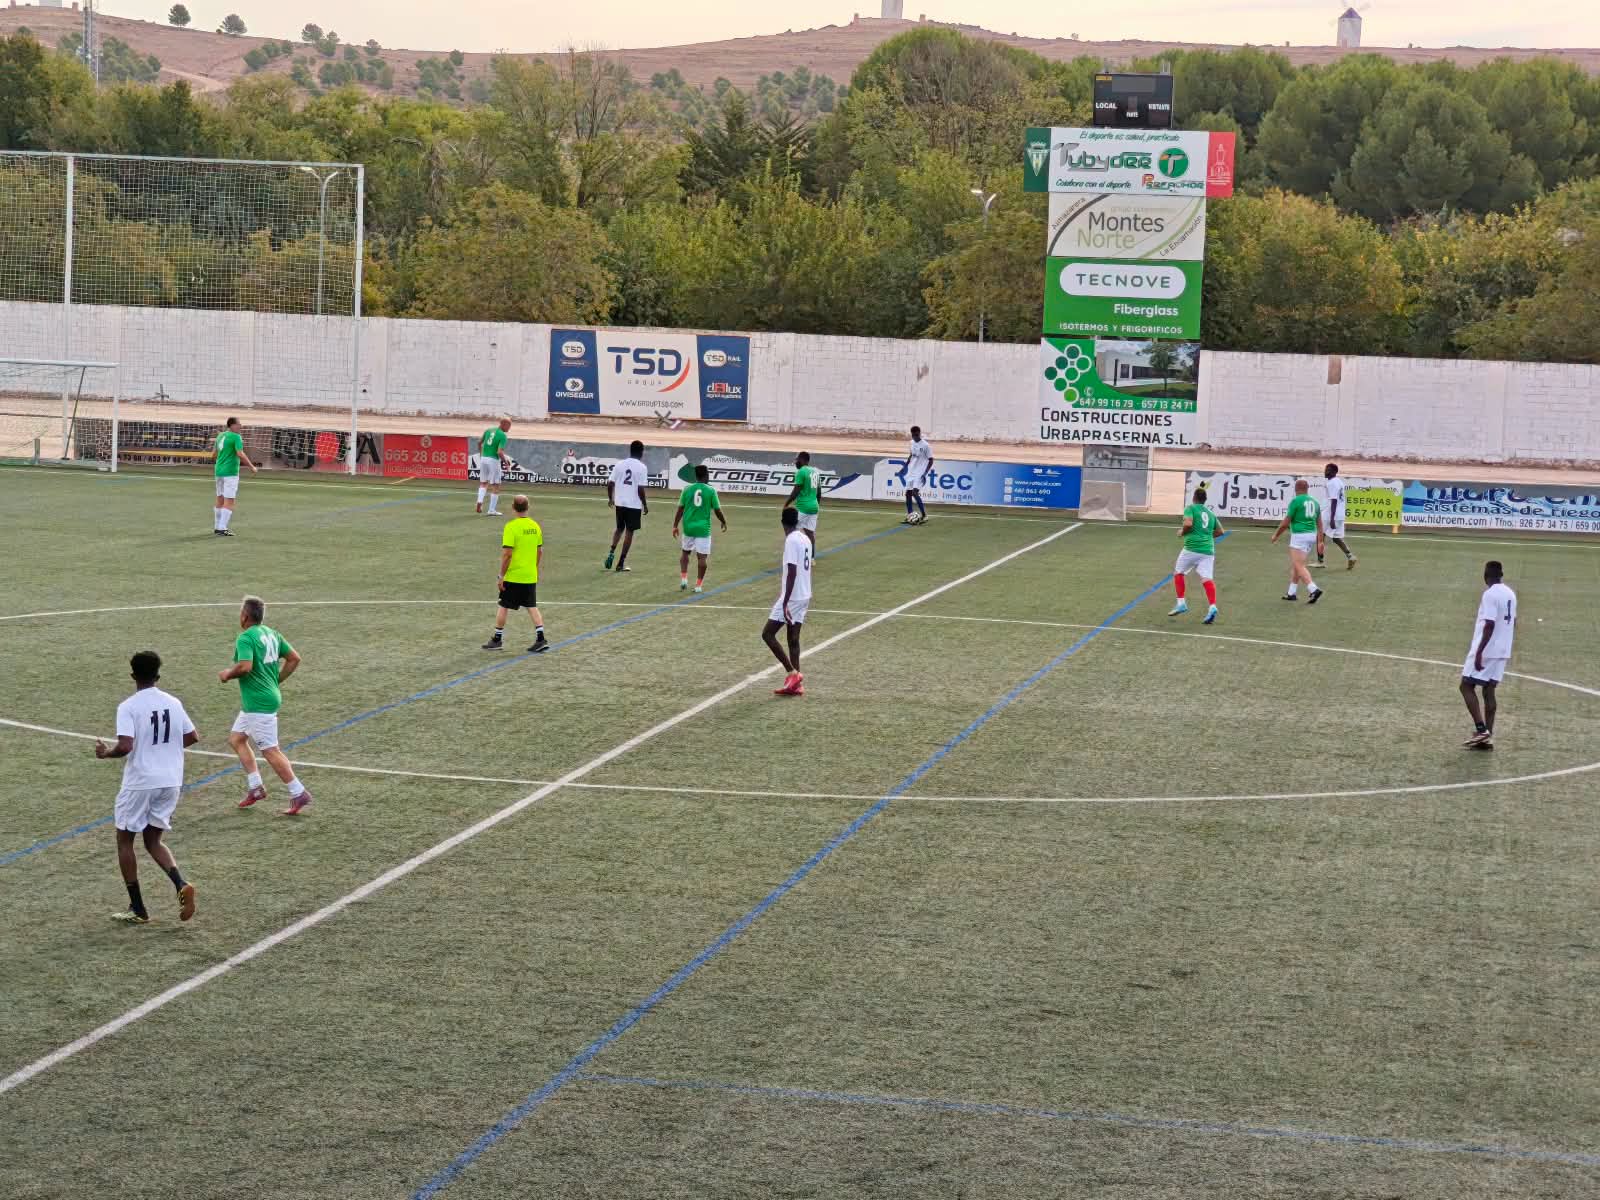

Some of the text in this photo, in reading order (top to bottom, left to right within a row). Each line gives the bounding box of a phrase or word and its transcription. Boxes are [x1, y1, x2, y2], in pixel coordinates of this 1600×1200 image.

[1088, 211, 1165, 233] Montes
[1077, 228, 1136, 249] Norte
[1076, 273, 1171, 289] TECNOVE
[1114, 303, 1179, 318] Fiberglass
[1059, 323, 1109, 332] ISOTERMOS
[1121, 324, 1183, 334] FRIGORIFICOS
[565, 345, 583, 353] TSD
[607, 346, 682, 376] TSD
[706, 354, 724, 362] TSD
[555, 391, 594, 399] DIVISEGUR
[1123, 400, 1134, 408] 79
[1141, 400, 1158, 408] 657
[1171, 401, 1182, 409] 24
[487, 433, 495, 445] 3
[1166, 433, 1192, 446] S.L.
[386, 449, 408, 462] 665
[413, 451, 428, 463] 28
[431, 452, 447, 464] 68
[451, 452, 467, 465] 63
[623, 469, 632, 485] 2
[887, 460, 973, 491] Rtec
[694, 490, 702, 507] 6
[942, 492, 973, 500] Imagen
[1346, 497, 1391, 505] ESERVAS
[1303, 501, 1316, 518] 10
[1354, 510, 1367, 518] 57
[1370, 510, 1383, 518] 10
[1386, 511, 1399, 519] 61
[1520, 506, 1544, 515] de
[1552, 508, 1600, 518] riego
[1201, 512, 1209, 528] 9
[1404, 514, 1487, 525] www.hidroem.com
[1520, 519, 1533, 528] 926
[1536, 519, 1544, 528] 57
[1548, 520, 1556, 528] 34
[1560, 521, 1568, 529] 75
[1576, 521, 1589, 530] 659
[150, 709, 170, 745] 11
